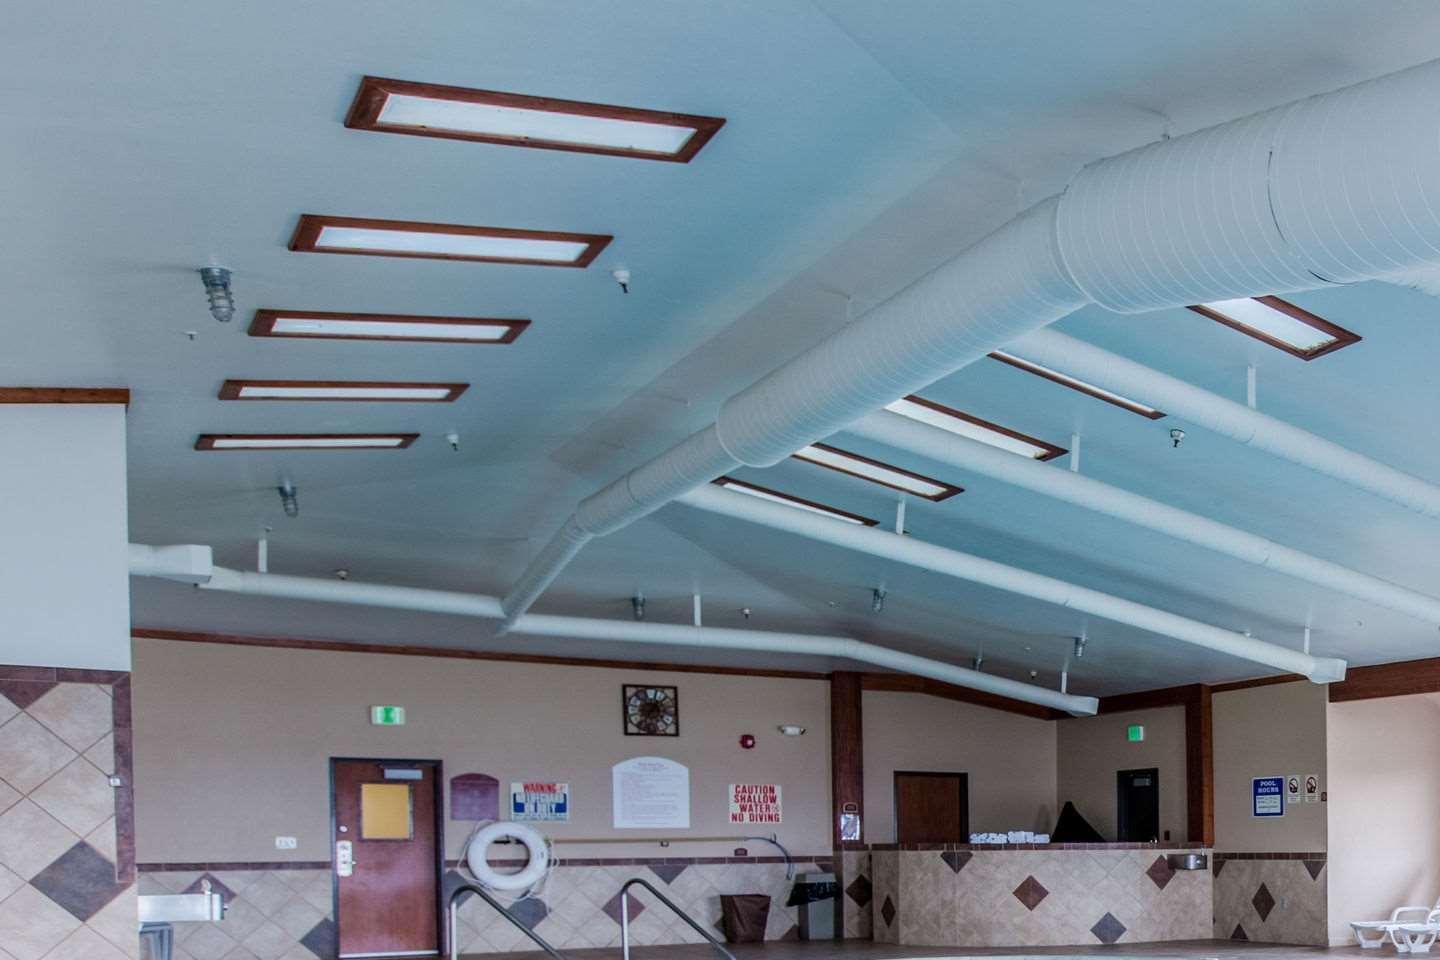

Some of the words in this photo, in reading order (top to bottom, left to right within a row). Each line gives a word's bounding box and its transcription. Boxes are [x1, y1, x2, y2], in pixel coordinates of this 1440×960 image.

[735, 784, 775, 794] CAUTION
[734, 794, 777, 803] SHALLOW
[739, 803, 771, 812] WATER
[731, 813, 744, 822] NO
[749, 813, 780, 822] DIVING
